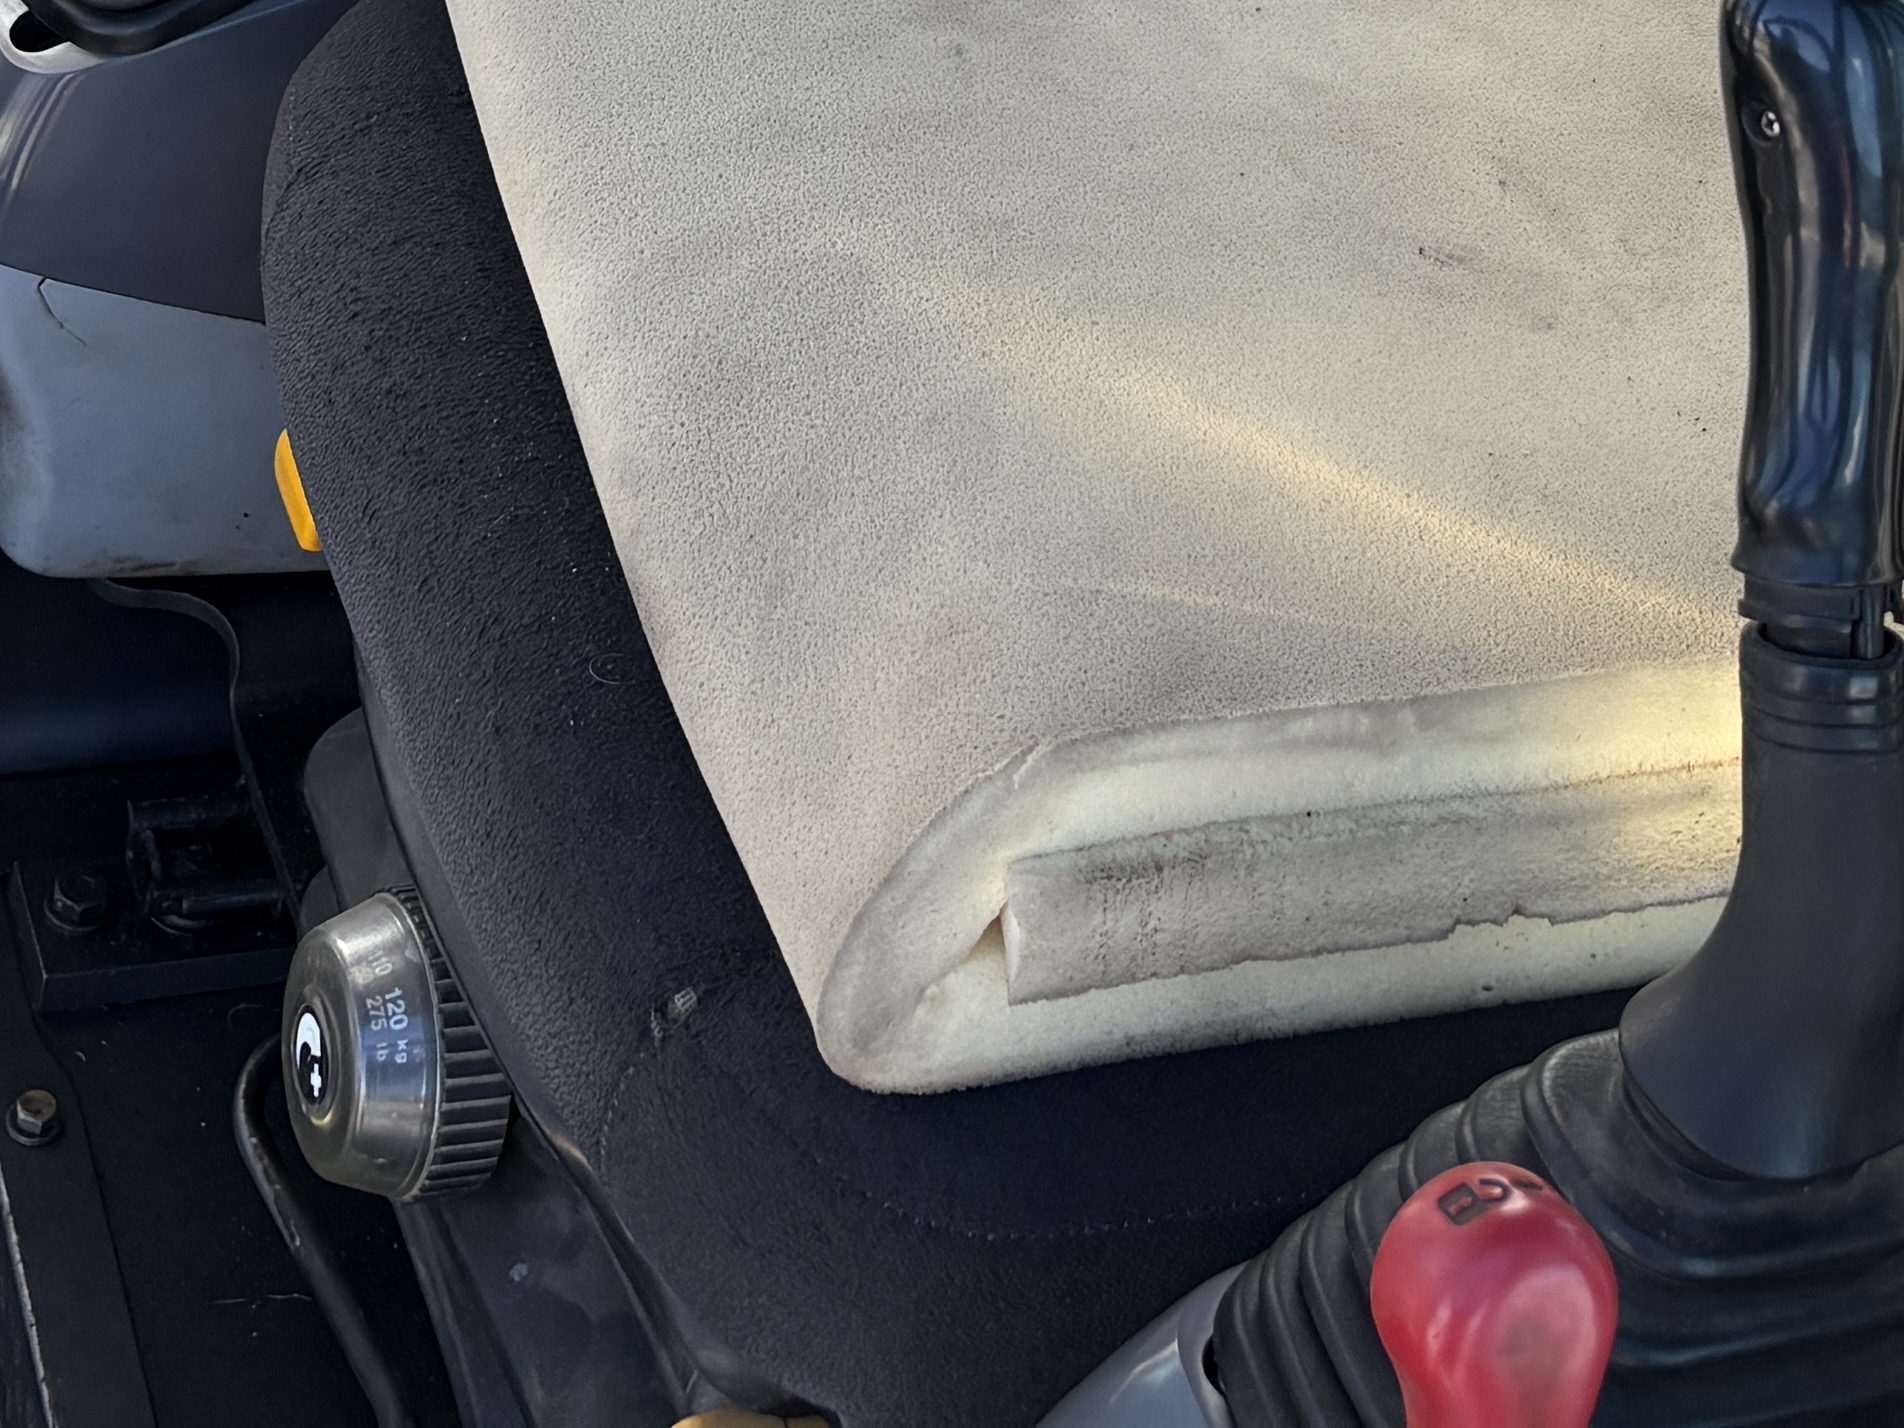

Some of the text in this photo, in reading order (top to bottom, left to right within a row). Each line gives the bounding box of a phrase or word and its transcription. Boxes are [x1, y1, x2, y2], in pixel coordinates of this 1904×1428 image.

[368, 950, 392, 976] 110
[366, 995, 389, 1061] 275 lb
[385, 987, 408, 1063] 120 kg
